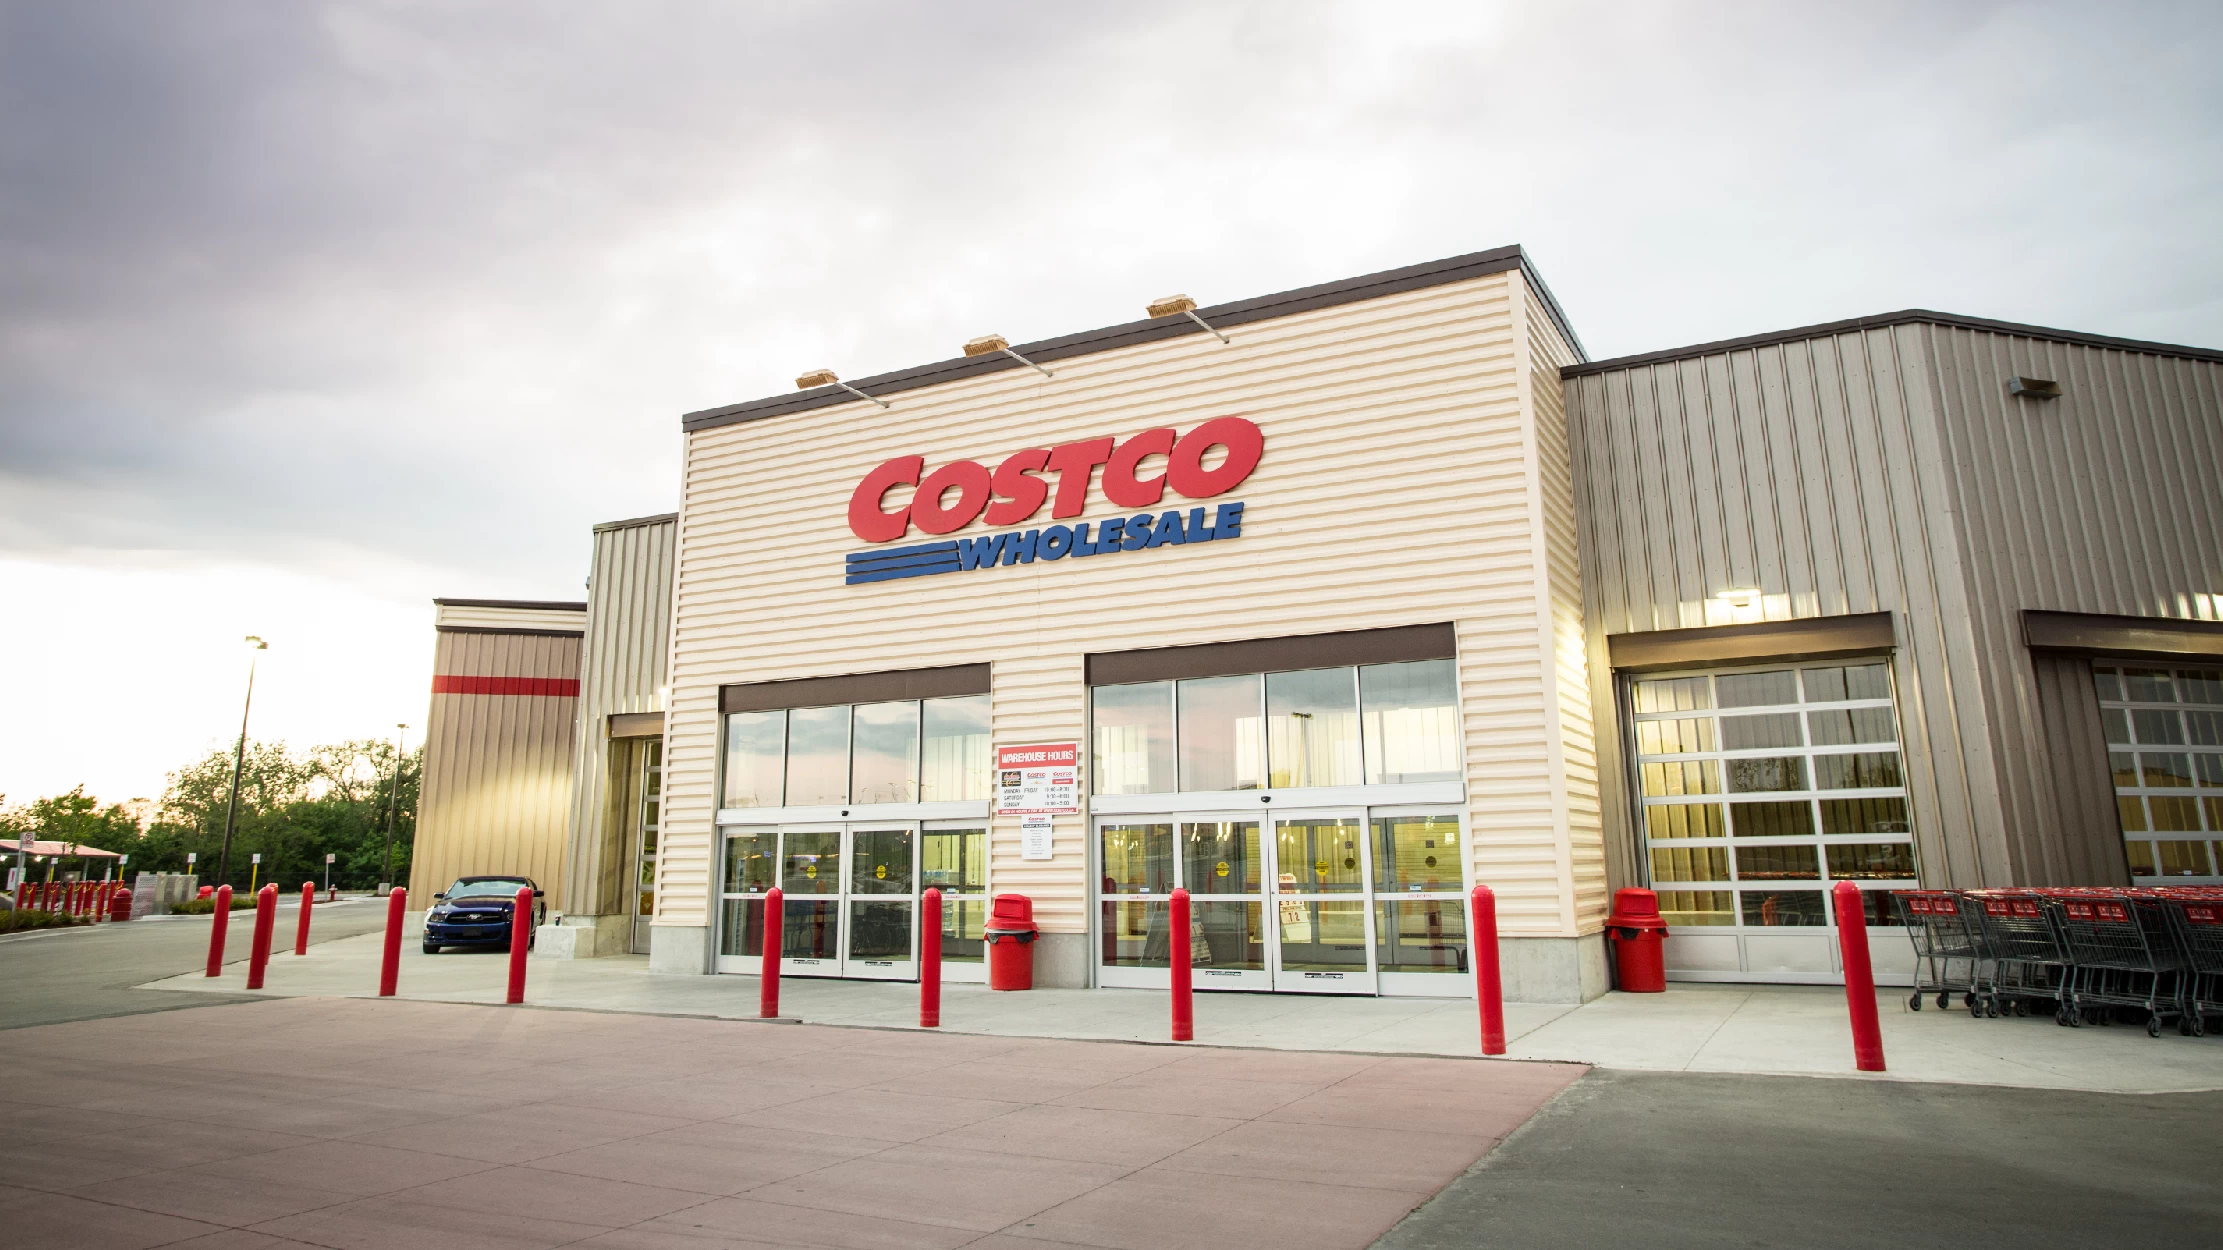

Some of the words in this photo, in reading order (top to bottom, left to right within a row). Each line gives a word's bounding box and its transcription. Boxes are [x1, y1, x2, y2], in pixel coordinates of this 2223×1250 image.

[848, 417, 1264, 543] COSTCO
[958, 502, 1245, 571] WHOLESALE
[1001, 751, 1047, 764] WAREHOUSE
[1048, 750, 1074, 761] HOURS
